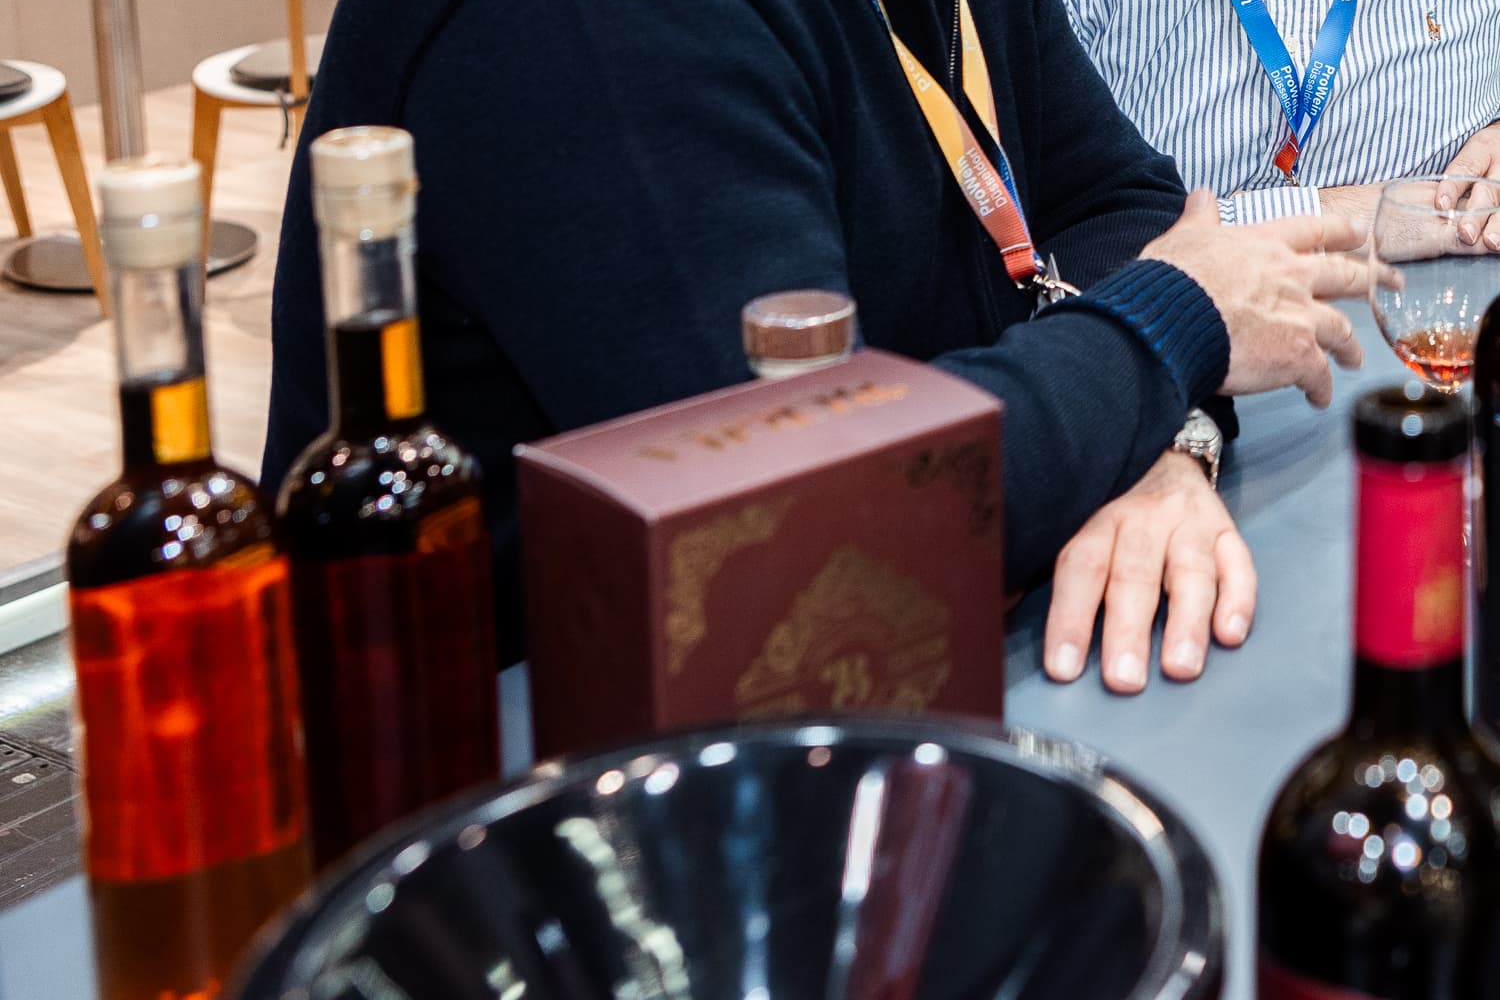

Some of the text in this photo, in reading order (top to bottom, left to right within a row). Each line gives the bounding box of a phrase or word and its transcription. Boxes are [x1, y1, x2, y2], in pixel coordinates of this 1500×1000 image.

[1280, 65, 1299, 117] ProWein
[1310, 64, 1336, 117] ProWein
[956, 155, 994, 218] ProWein
[965, 147, 1008, 208] Düsseldorf
